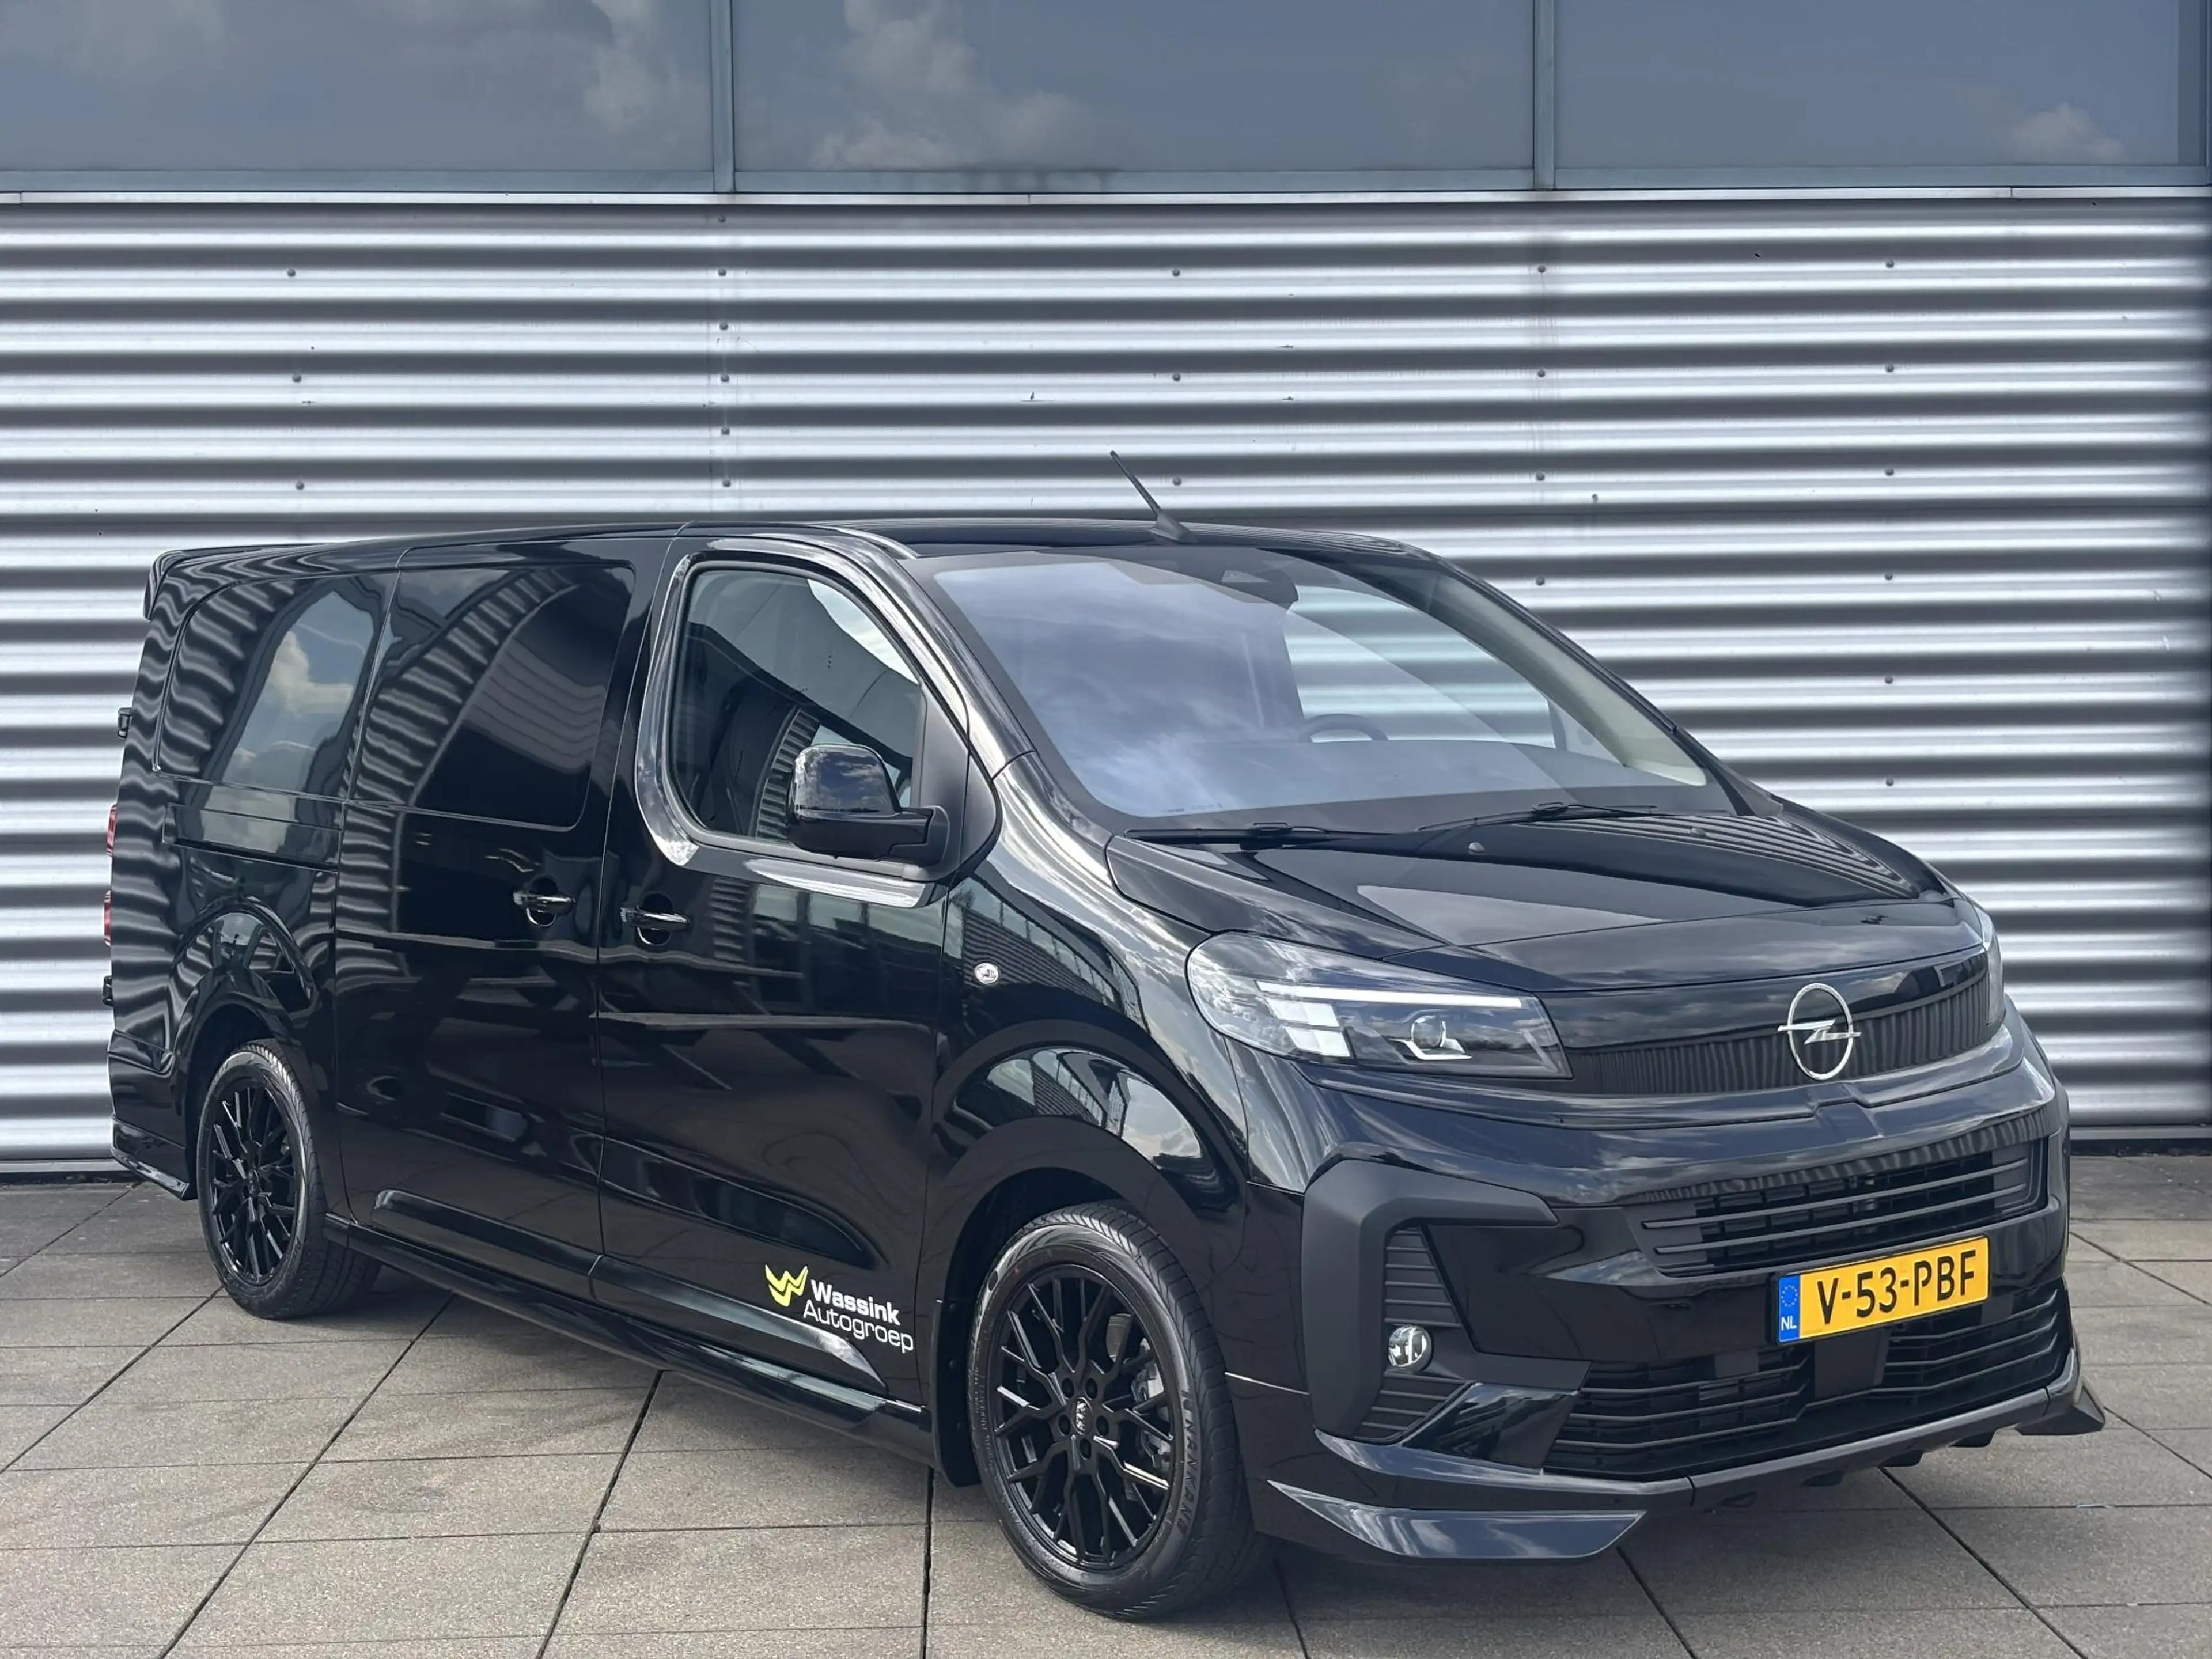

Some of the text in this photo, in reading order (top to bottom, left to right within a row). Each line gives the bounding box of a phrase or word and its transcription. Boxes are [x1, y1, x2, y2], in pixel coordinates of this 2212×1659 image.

[811, 1279, 900, 1325] Wassink
[1816, 1249, 1976, 1325] V-53-PBF
[804, 1299, 914, 1353] Autogroep
[1781, 1315, 1797, 1331] NL
